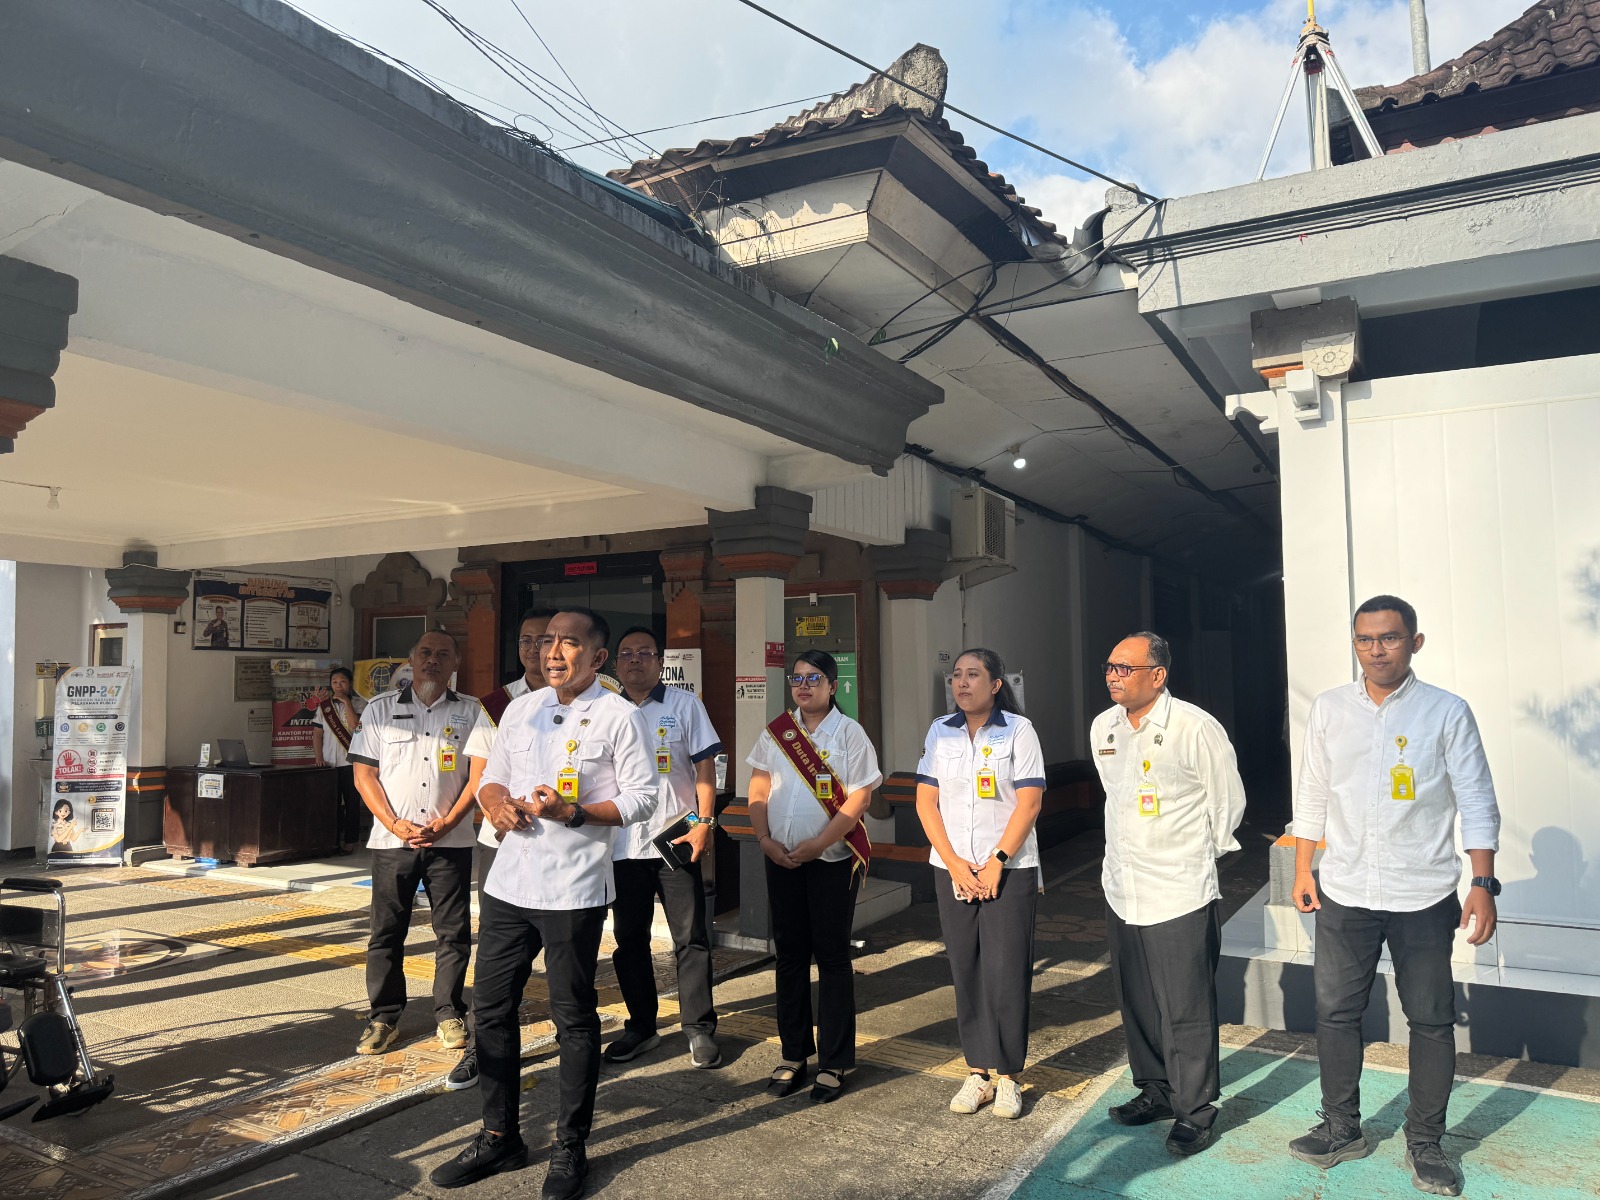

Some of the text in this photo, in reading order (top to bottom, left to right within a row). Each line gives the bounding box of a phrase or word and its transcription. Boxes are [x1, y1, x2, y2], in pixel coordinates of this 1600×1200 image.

[660, 666, 685, 681] ZONA
[67, 686, 122, 697] GNPP-247
[791, 741, 810, 766] Duta
[58, 765, 82, 775] TOLAK!
